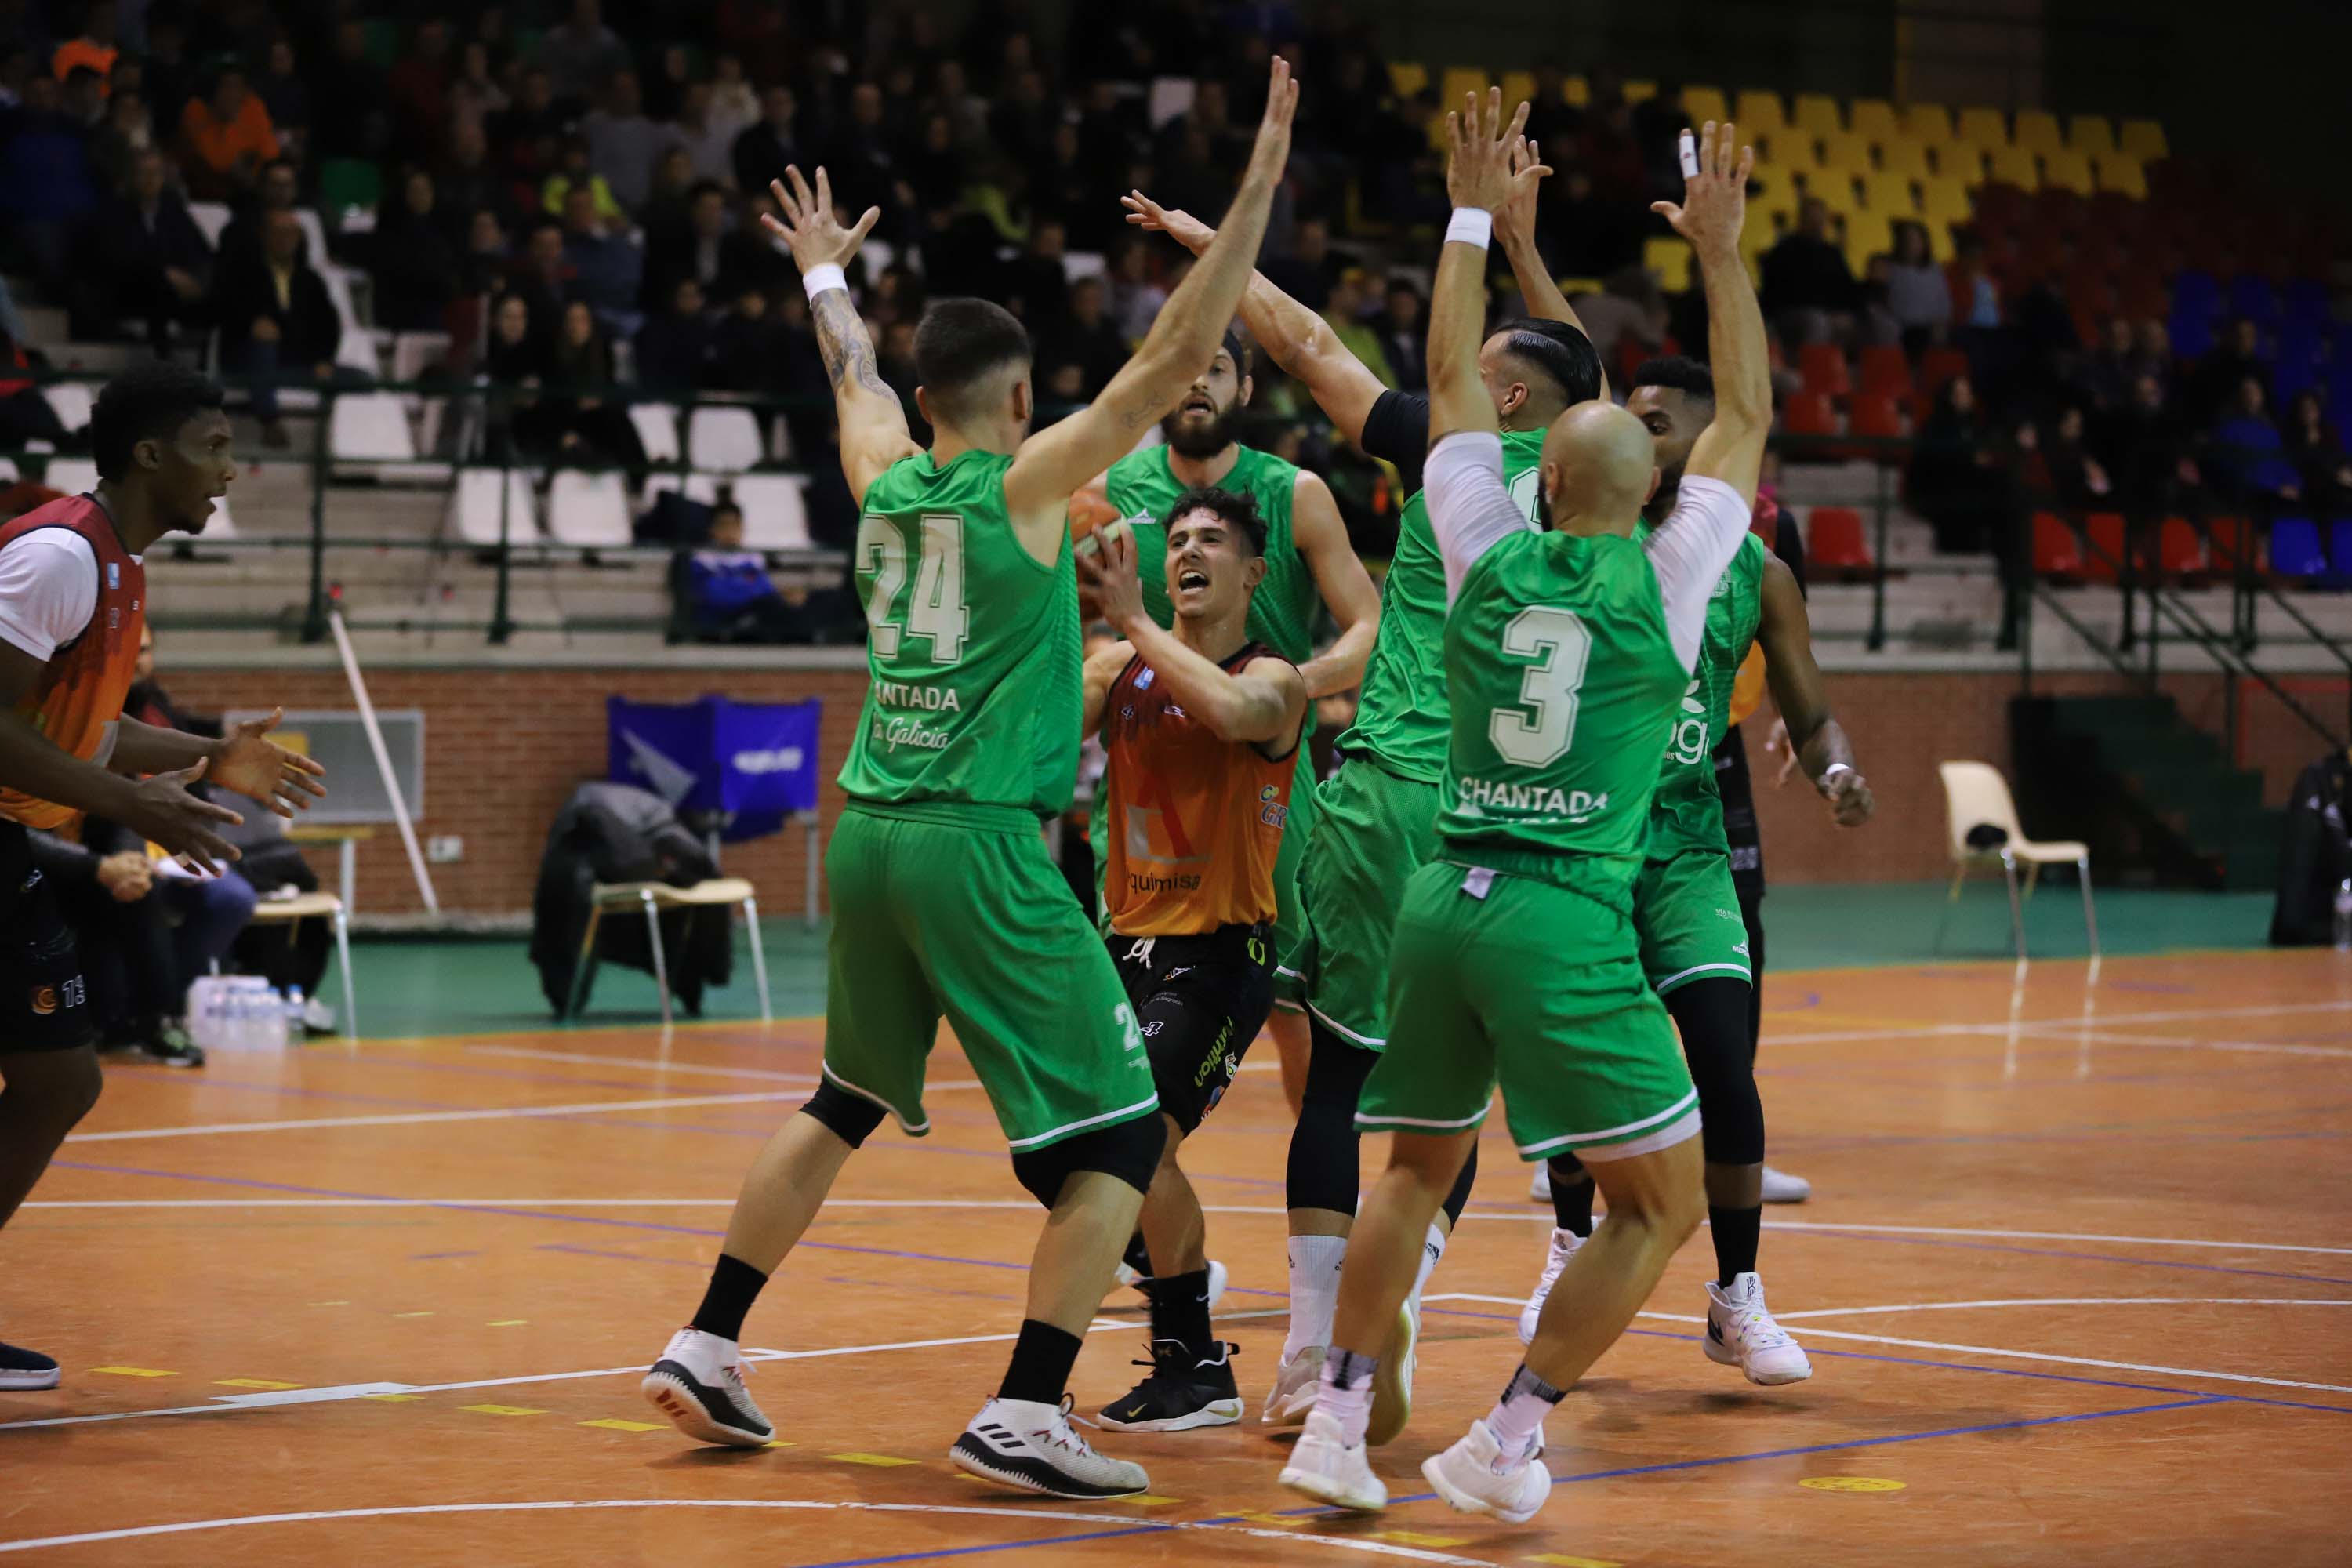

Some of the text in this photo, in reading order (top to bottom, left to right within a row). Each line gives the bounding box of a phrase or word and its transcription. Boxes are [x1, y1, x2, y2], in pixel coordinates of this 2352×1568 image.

[856, 514, 970, 665] 24
[1488, 604, 1593, 770] 3
[886, 717, 949, 753] Galicia
[1458, 775, 1609, 815] CHANTADA
[1130, 872, 1202, 895] quimisa
